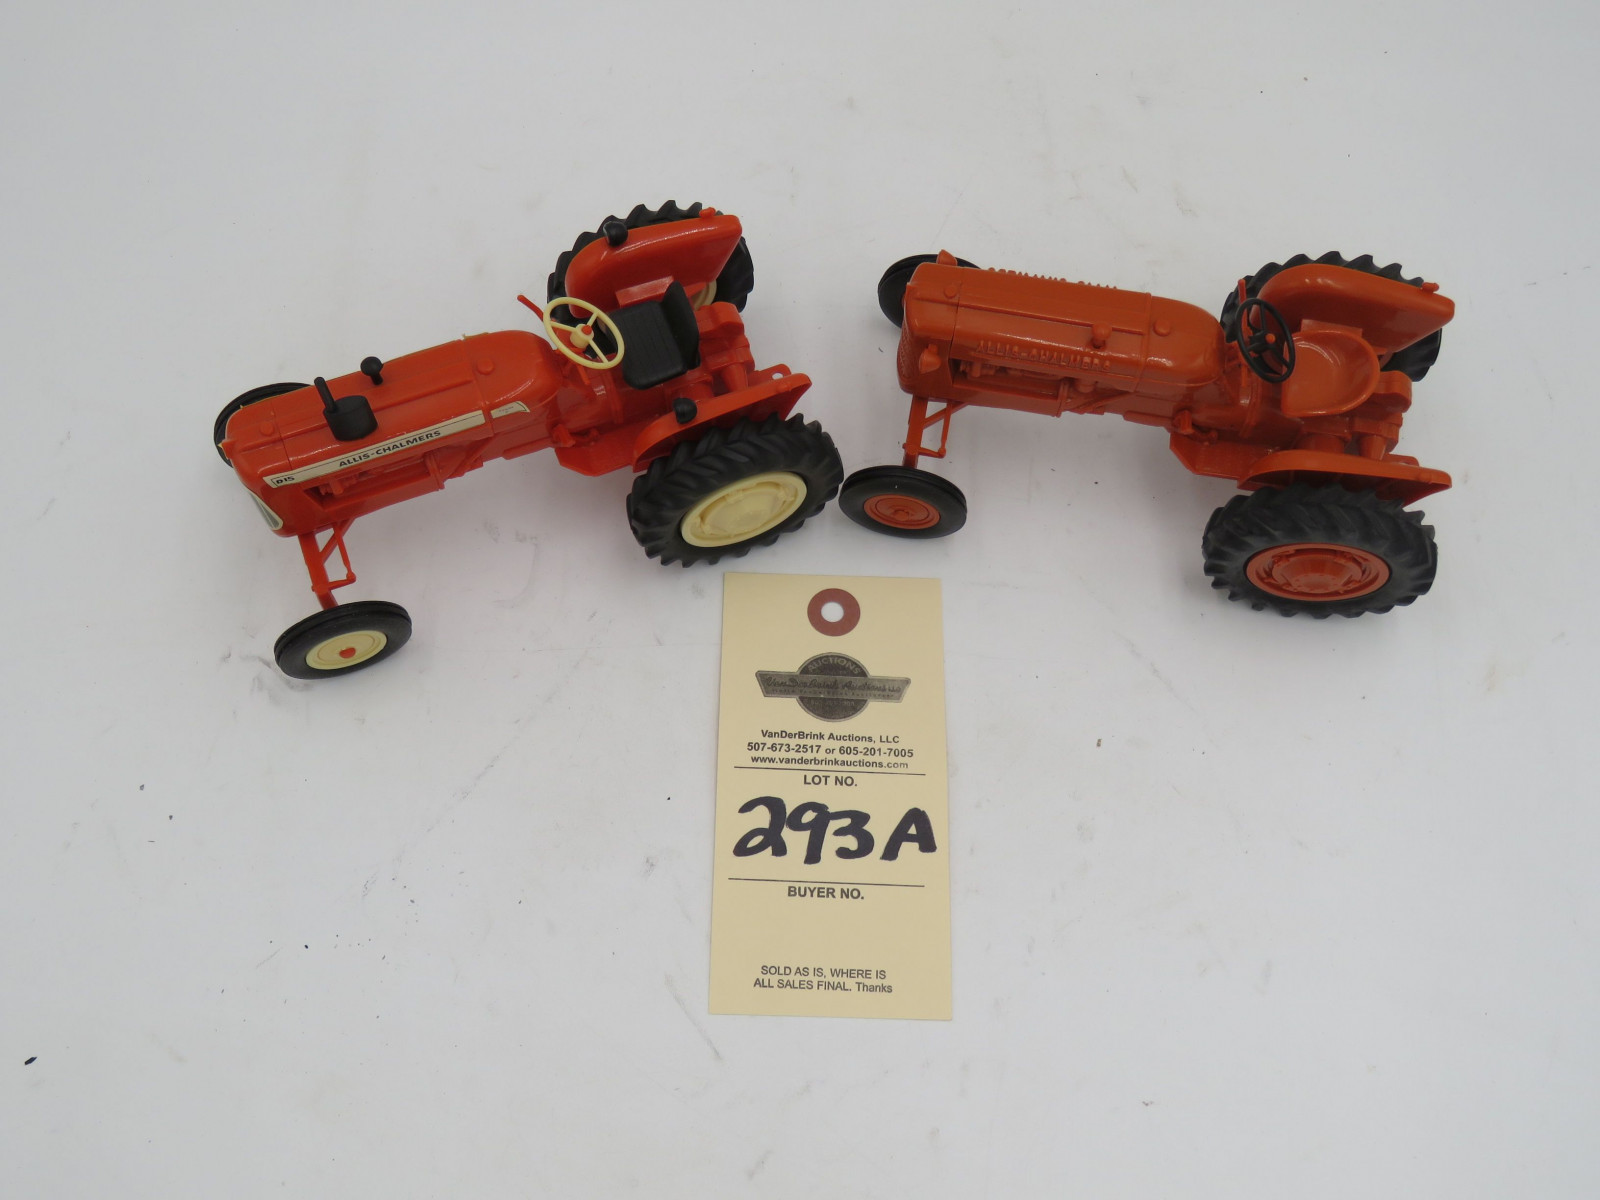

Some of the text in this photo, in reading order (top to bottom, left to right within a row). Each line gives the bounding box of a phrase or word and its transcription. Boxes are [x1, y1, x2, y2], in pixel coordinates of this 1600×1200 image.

[338, 430, 442, 468] ALLIS-CHALMERS
[275, 475, 295, 486] D15
[808, 656, 862, 675] AUCTIONS
[761, 729, 900, 744] VanDerBrink Auctions, LLC
[747, 742, 914, 758] 507-673-2517 or 605-201-7005
[751, 756, 909, 769] www.vanderbrinkauctions.com
[803, 774, 858, 787] LOT NO.
[787, 886, 864, 900] BUYER NO.
[761, 965, 887, 980] SOLD AS IS, WHERE IS
[753, 978, 893, 993] ALL SALES FINAL. Thanks
